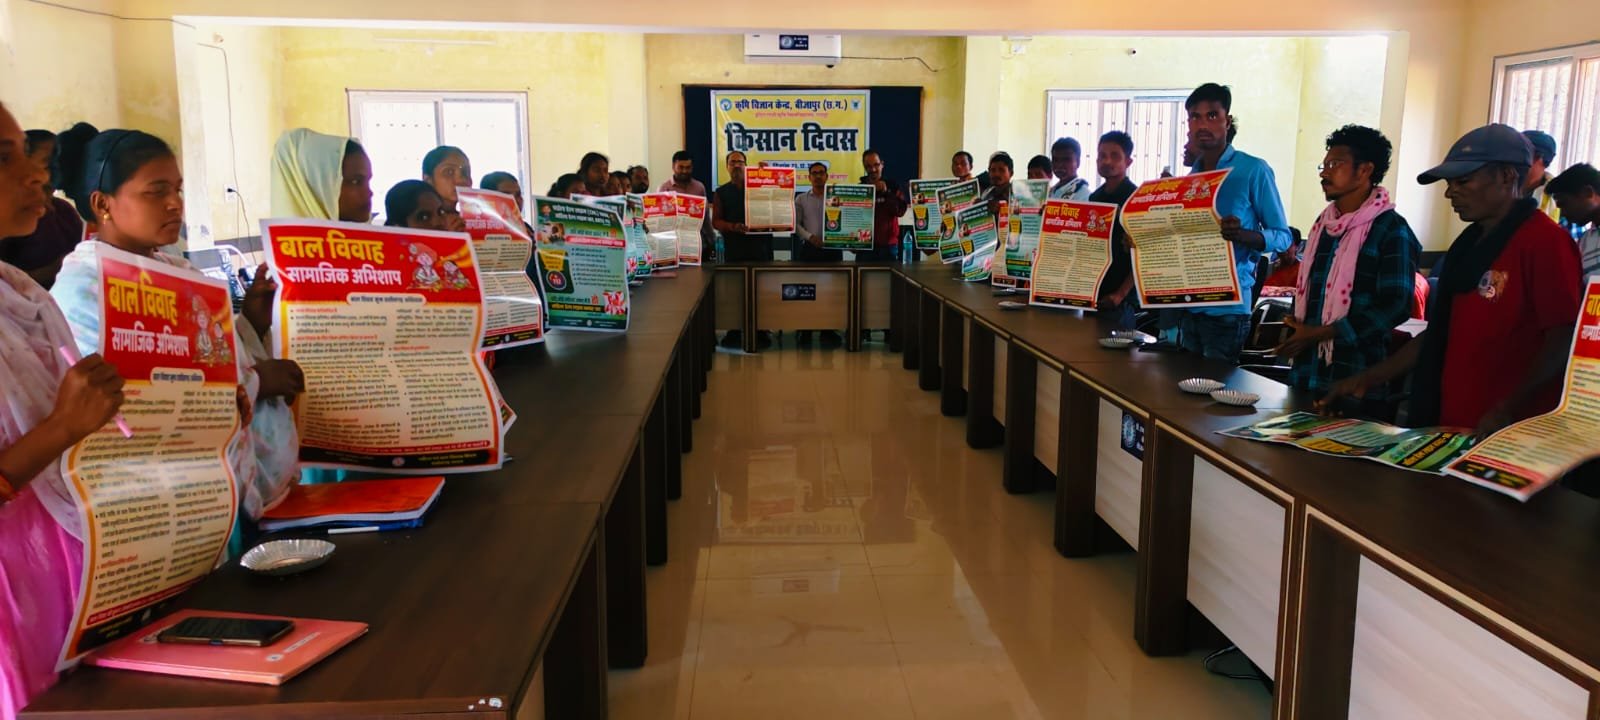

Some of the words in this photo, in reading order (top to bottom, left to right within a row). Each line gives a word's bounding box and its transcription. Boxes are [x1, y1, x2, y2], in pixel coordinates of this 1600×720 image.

[724, 122, 798, 152] किसान
[799, 122, 859, 152] दिवस
[1046, 205, 1061, 216] बाल
[1060, 203, 1081, 219] विवाह
[276, 236, 324, 259] बाल
[325, 229, 386, 265] विवाह
[285, 261, 350, 284] सामाजिक
[350, 263, 403, 286] अभिशाप
[107, 275, 140, 315] बाल
[139, 269, 178, 327] विवाह
[1586, 293, 1600, 316] बा
[111, 320, 155, 354] सामाजिक
[155, 325, 190, 357] अभिशाप
